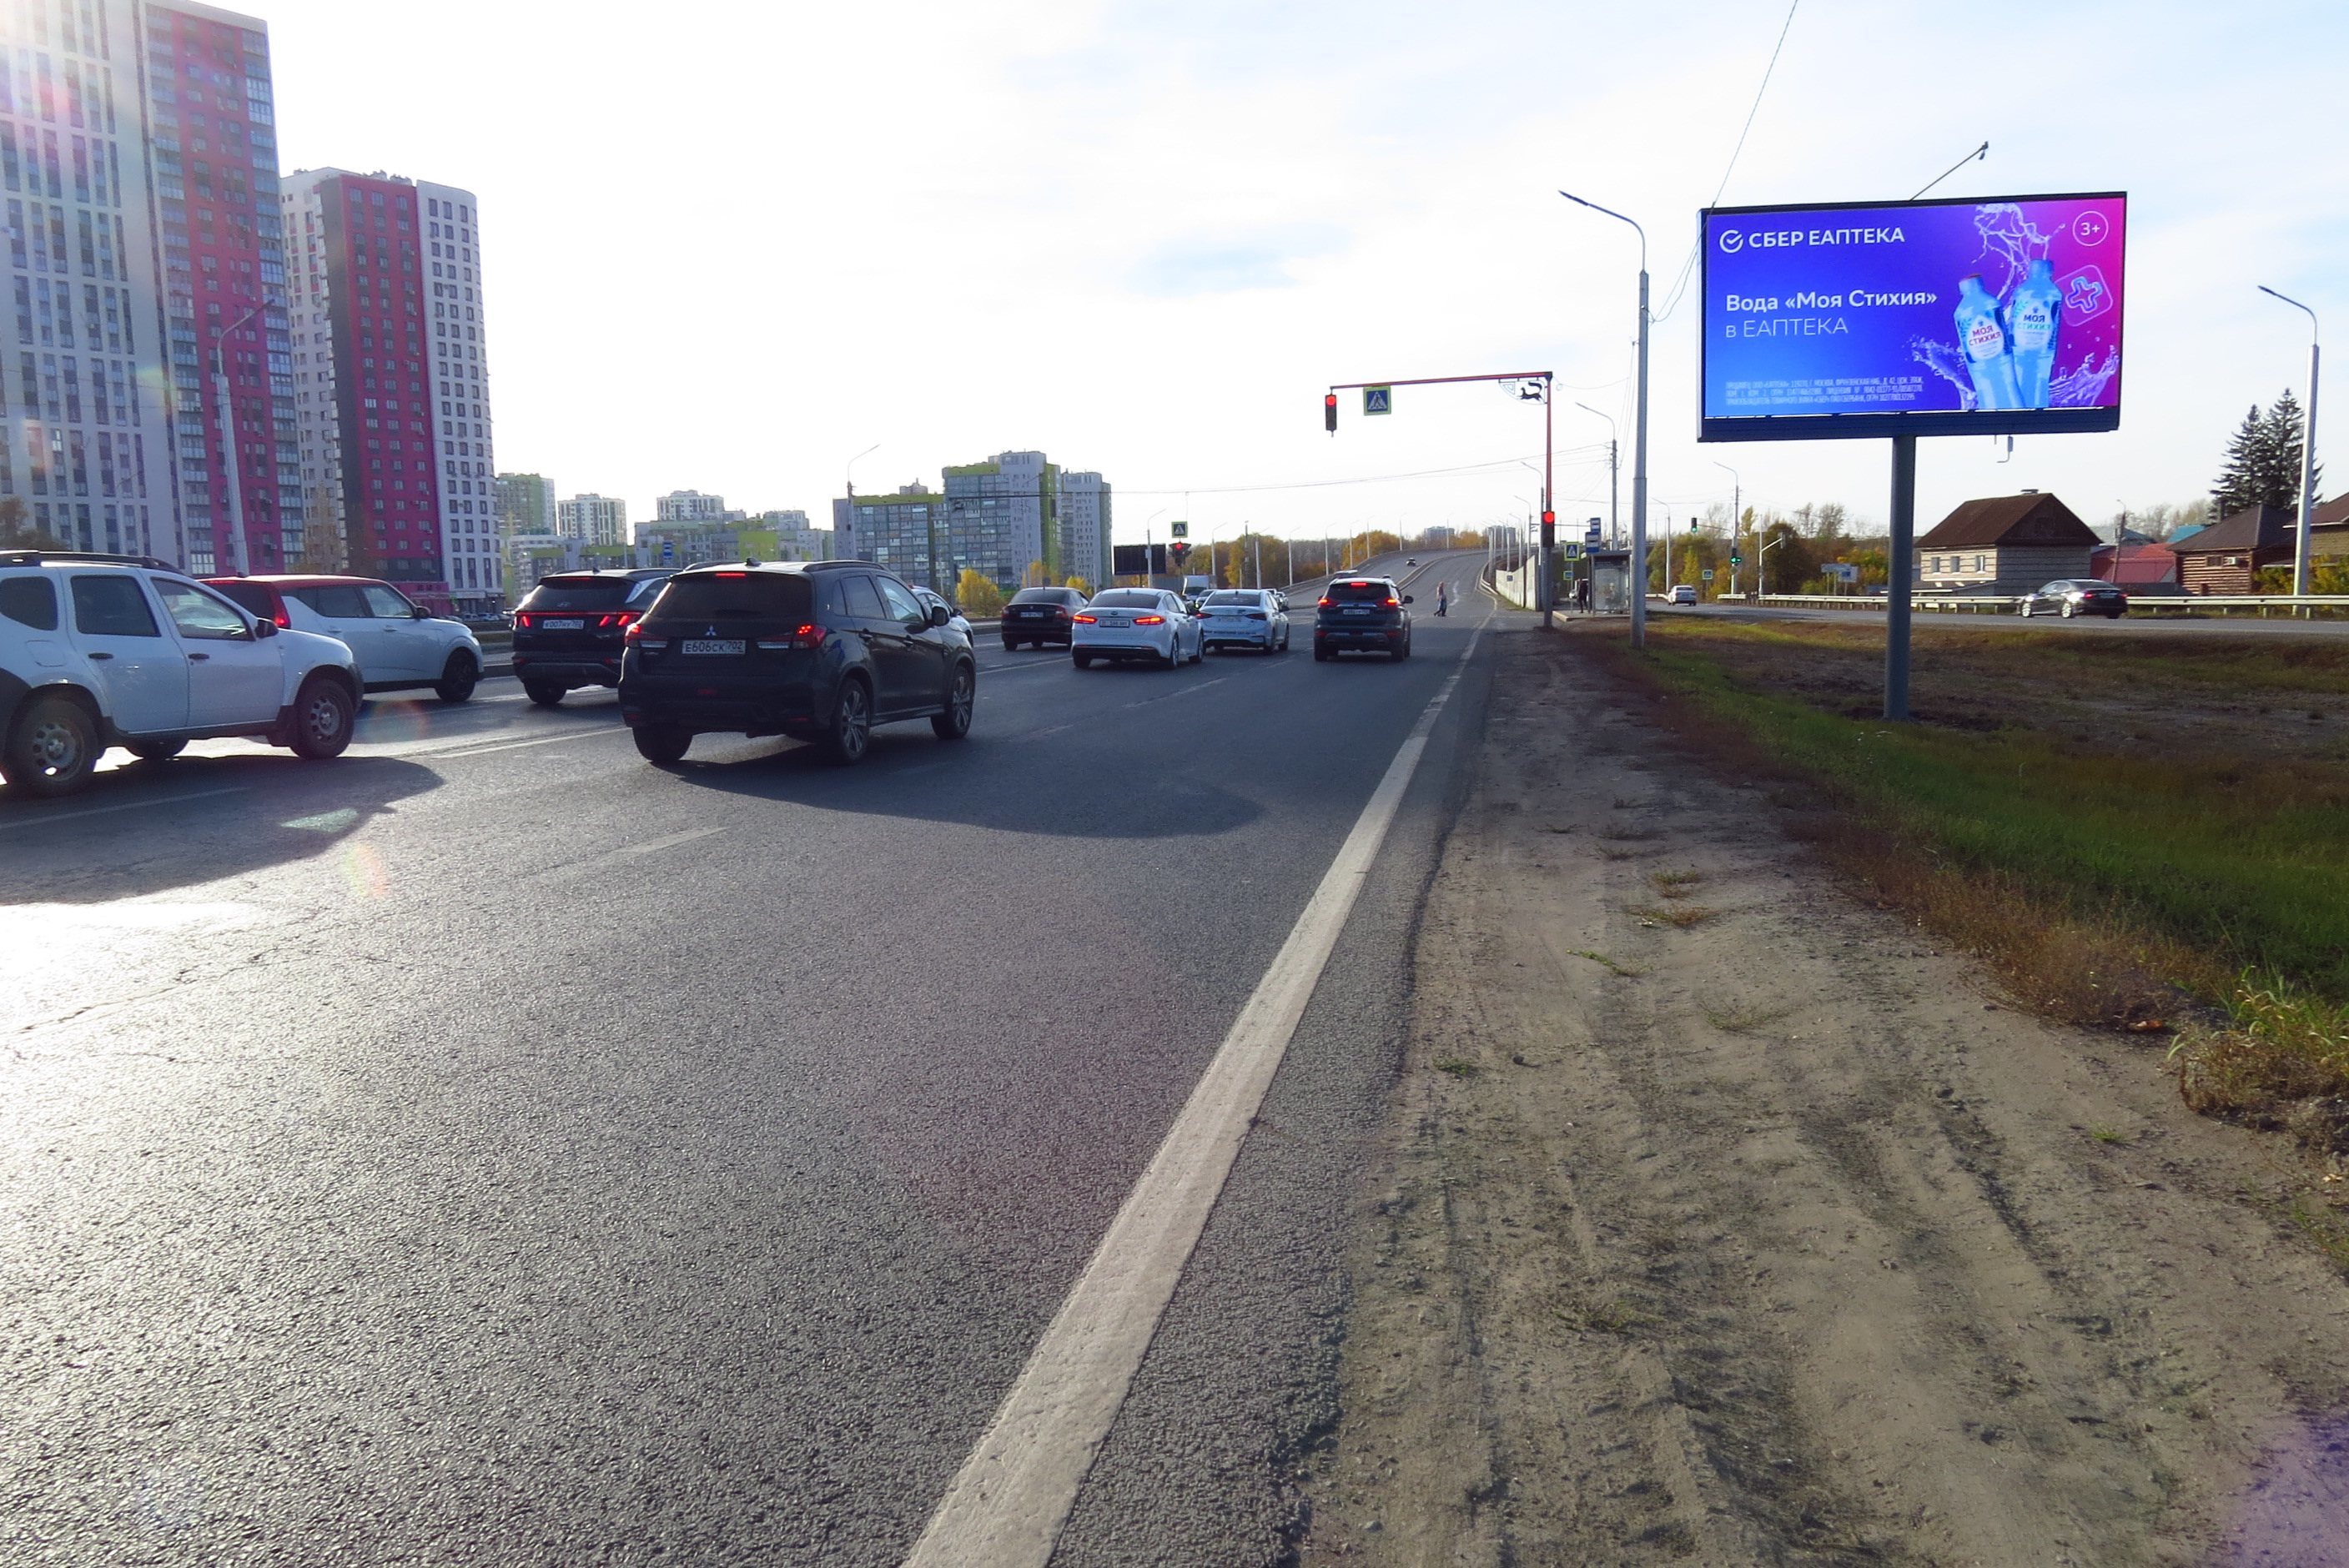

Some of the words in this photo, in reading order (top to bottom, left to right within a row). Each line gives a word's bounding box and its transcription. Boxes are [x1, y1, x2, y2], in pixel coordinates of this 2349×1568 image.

[2080, 222, 2100, 236] 3+
[1748, 231, 1803, 248] СБЕР
[1808, 228, 1905, 245] ЕАПТЕКА
[1726, 294, 1778, 313] Вода
[1785, 291, 1842, 309] «Моя
[1849, 289, 1937, 307] Стихия»
[1725, 325, 1736, 338] в
[1743, 317, 1849, 337] ЕАПТЕКА
[1972, 325, 1994, 337] МОЯ
[1969, 331, 2002, 346] СТИХИЯ
